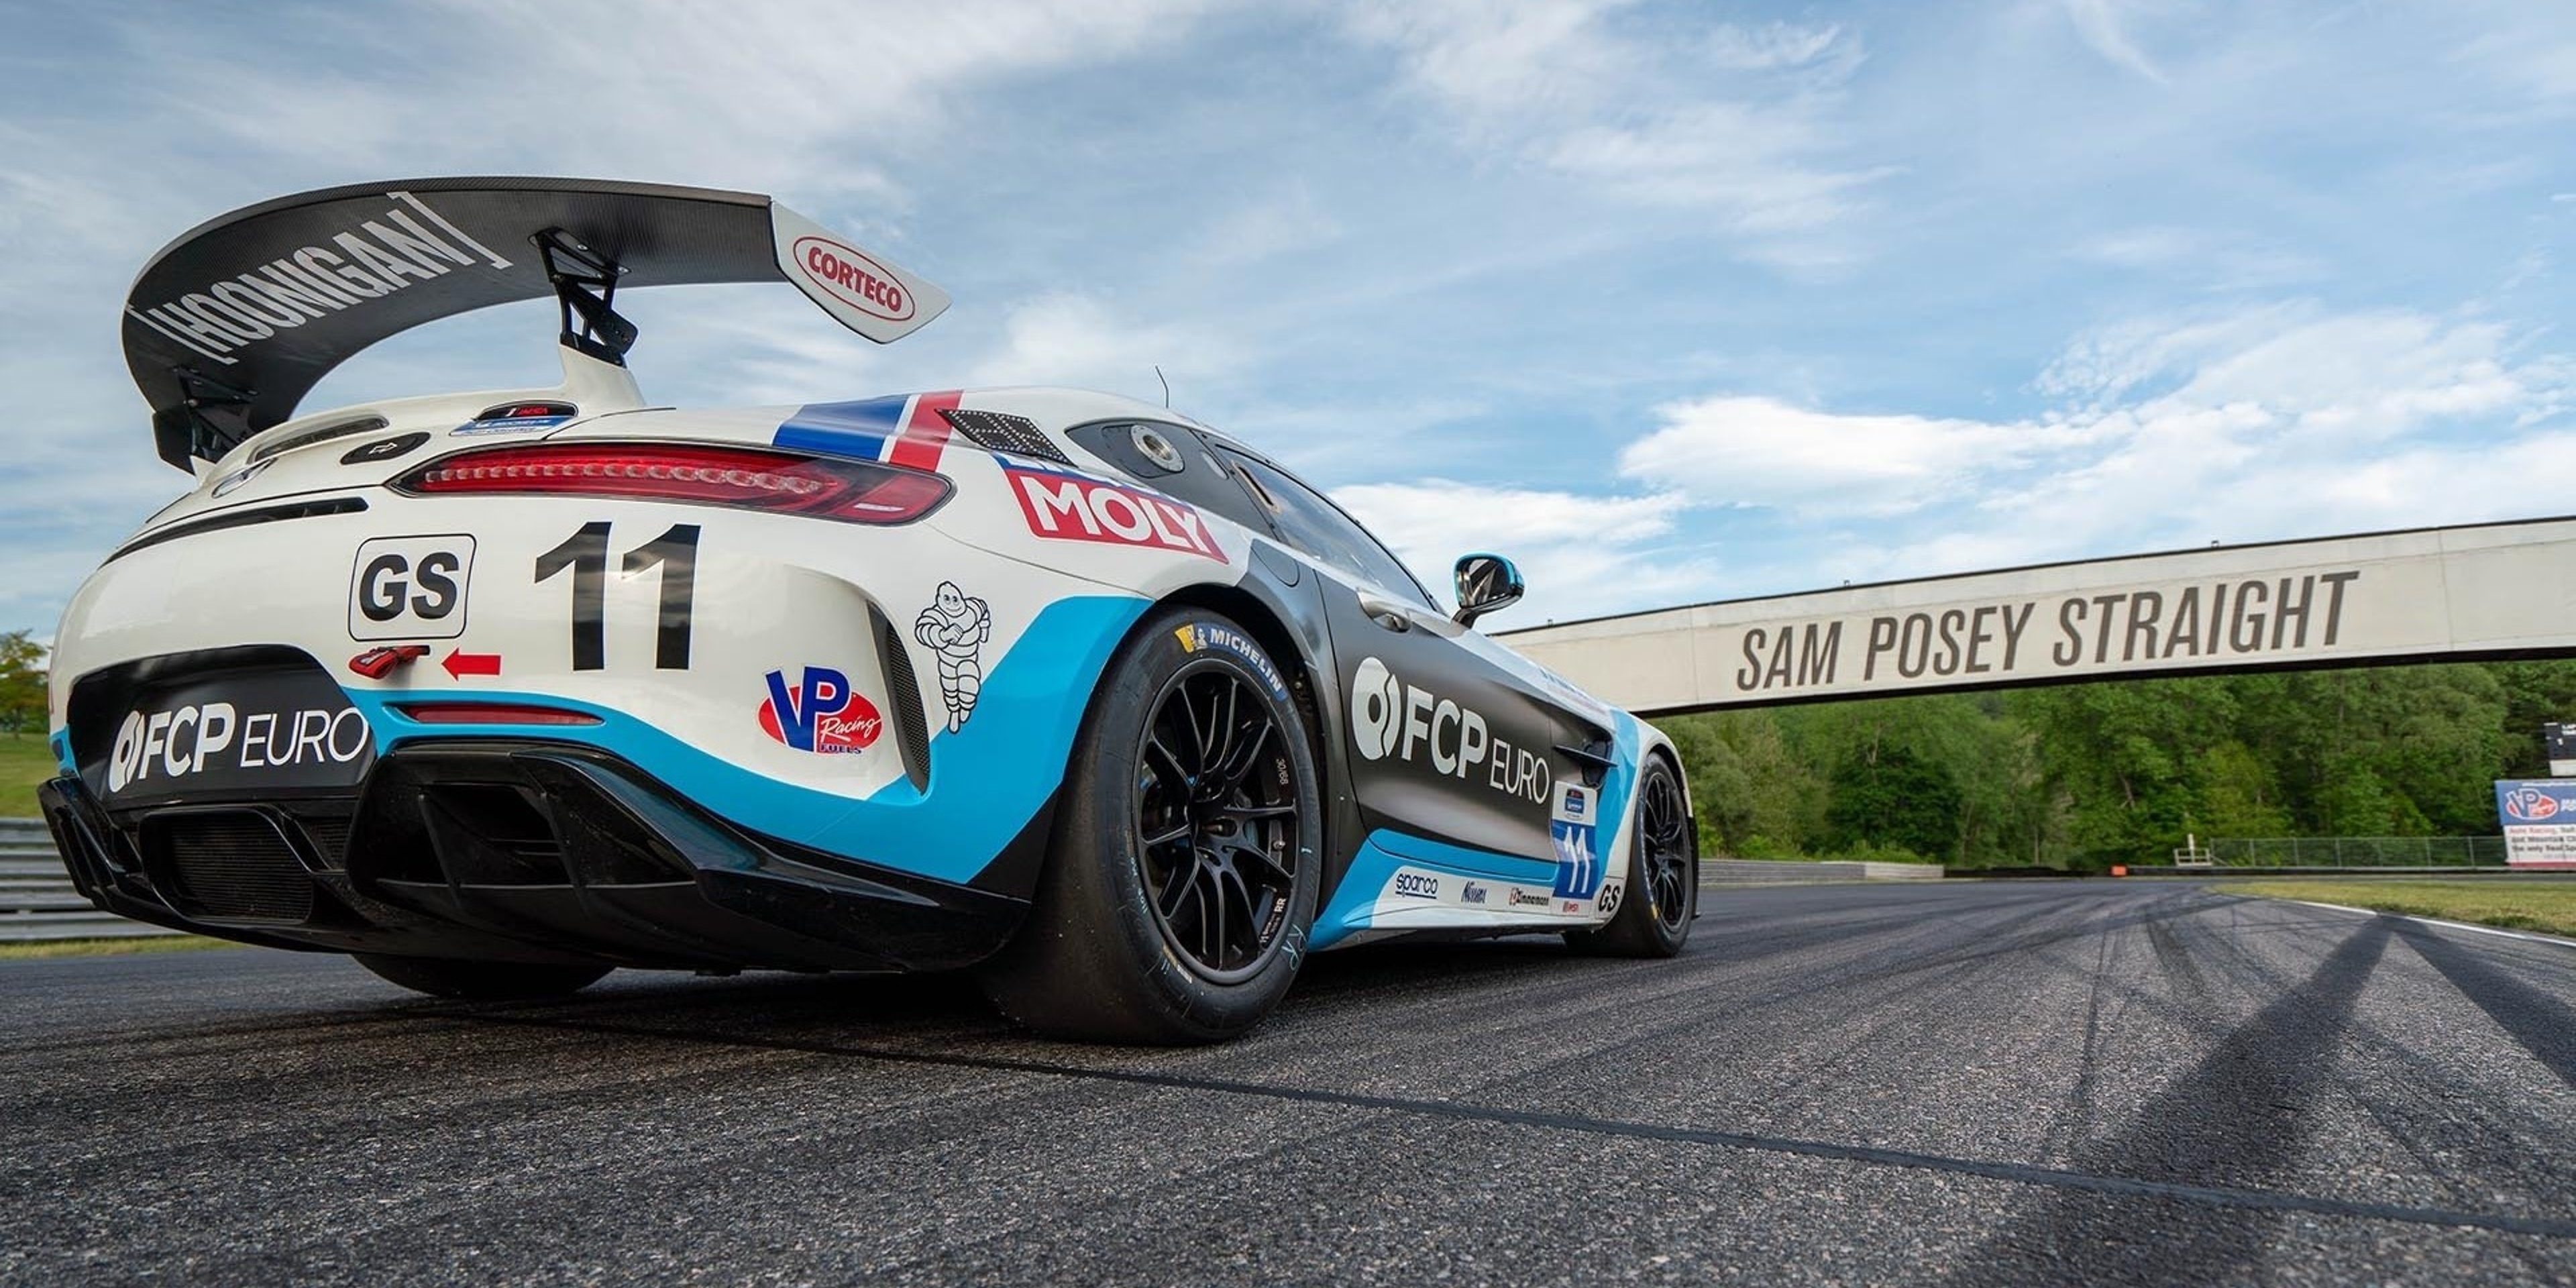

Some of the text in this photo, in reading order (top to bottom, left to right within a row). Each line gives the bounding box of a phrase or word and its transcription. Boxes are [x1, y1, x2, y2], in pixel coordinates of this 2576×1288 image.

[808, 246, 902, 313] CORTECO
[1020, 476, 1212, 553] MOLY
[359, 551, 459, 621] GS
[535, 521, 701, 671] 11
[1210, 628, 1283, 692] MICHELIN
[1737, 571, 2360, 691] SAM POSEY STRAIGHT
[138, 702, 369, 780] FCP EURO
[765, 666, 850, 752] VP
[820, 716, 881, 743] Racing
[820, 743, 863, 755] FUELS
[1401, 684, 1488, 778] FCP
[1489, 738, 1550, 804] EURO
[1395, 873, 1438, 896] sparco
[1564, 826, 1591, 894] 11
[1598, 883, 1620, 912] GS
